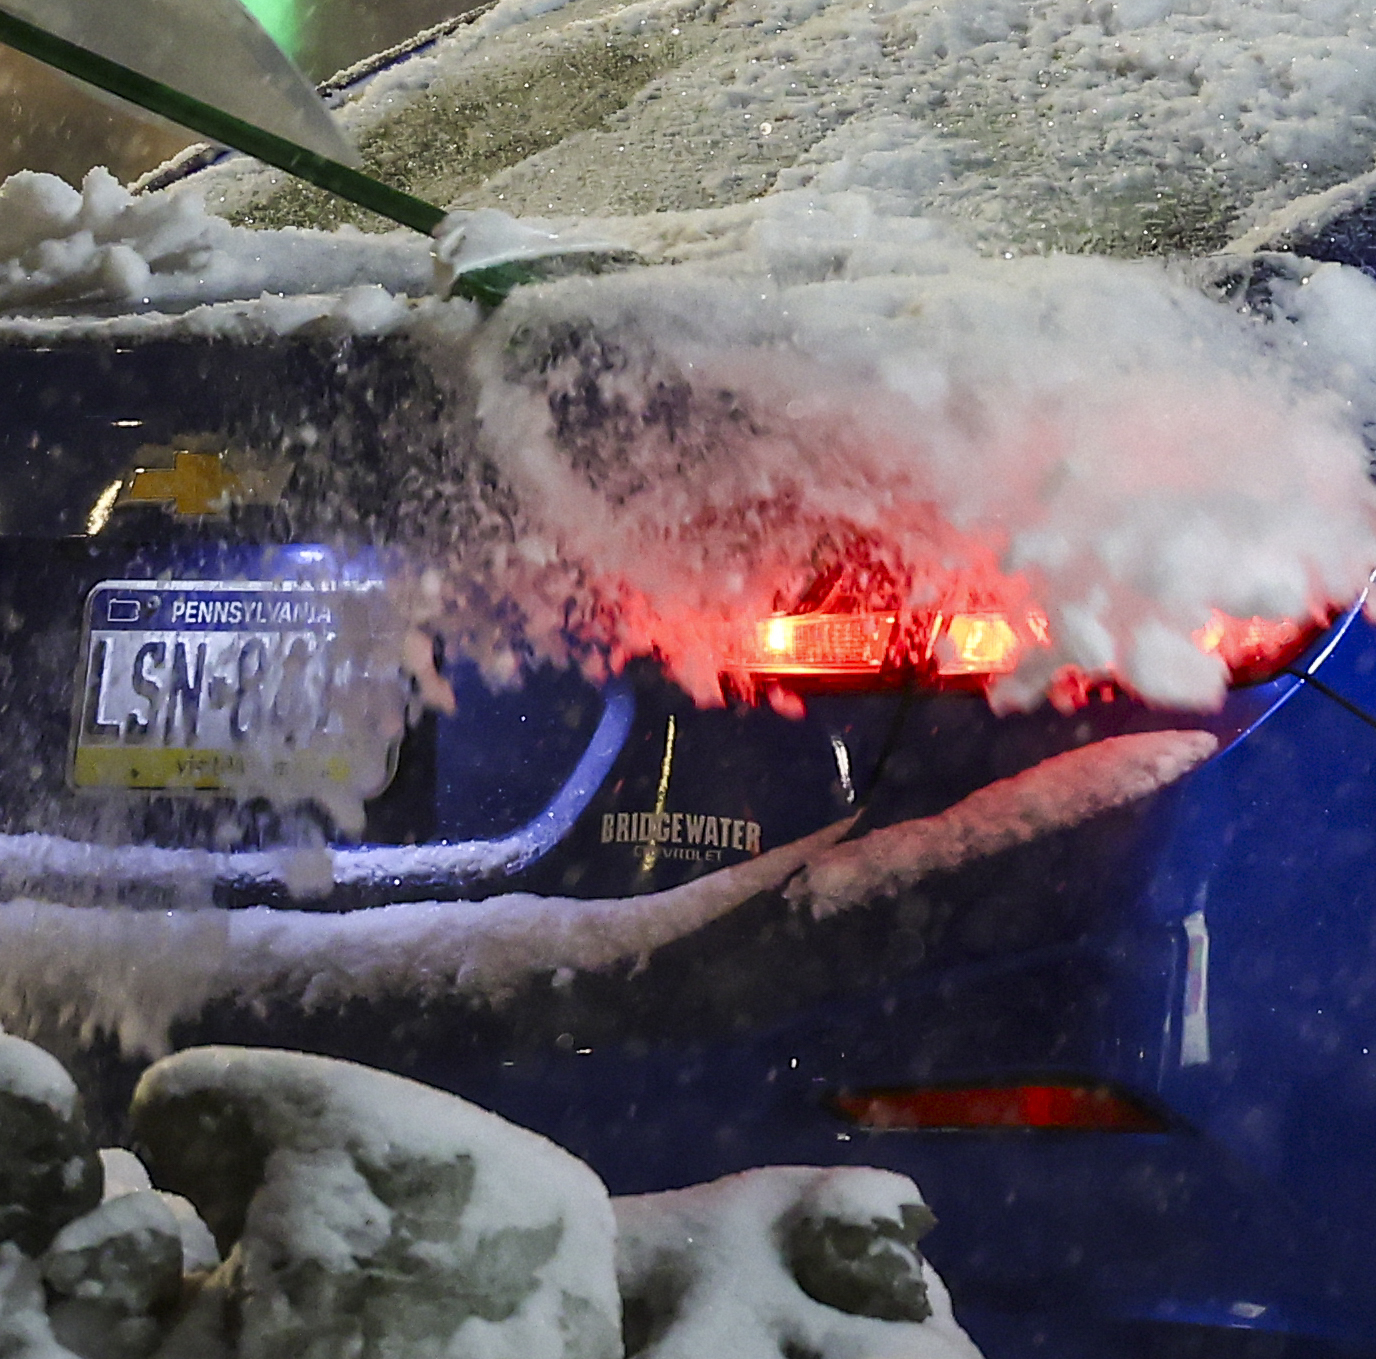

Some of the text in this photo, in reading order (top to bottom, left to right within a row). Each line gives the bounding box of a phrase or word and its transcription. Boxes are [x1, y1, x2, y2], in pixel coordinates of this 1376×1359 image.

[170, 600, 332, 624] PENNSYLVANIA
[600, 812, 762, 856] BRIDGEWATER
[633, 844, 722, 862] CVROLET
